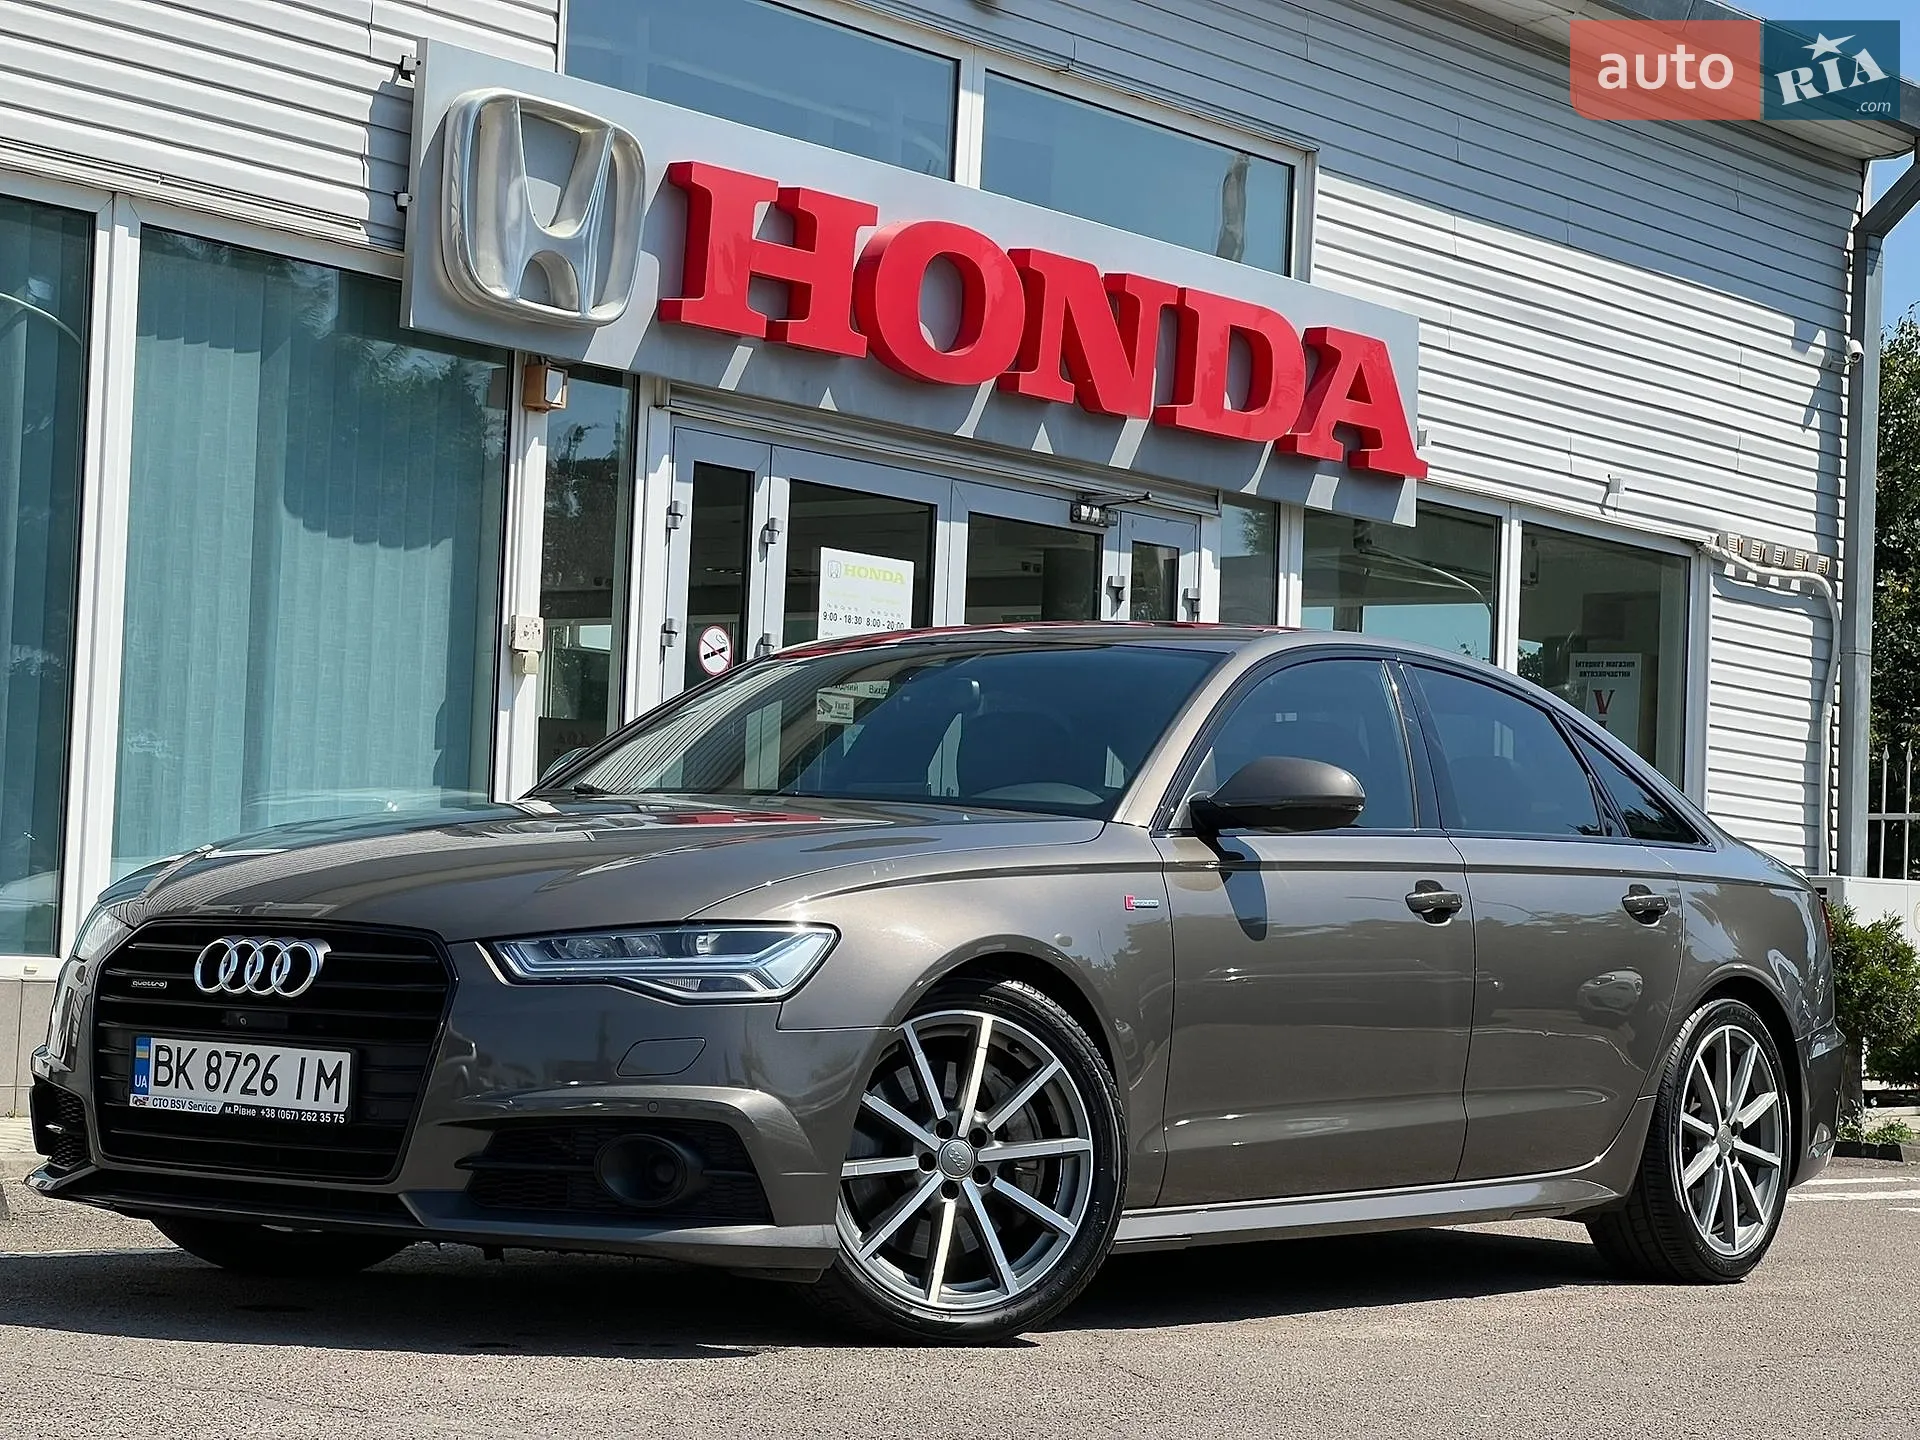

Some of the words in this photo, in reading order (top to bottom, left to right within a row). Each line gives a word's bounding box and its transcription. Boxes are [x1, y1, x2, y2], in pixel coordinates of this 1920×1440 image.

[657, 161, 1428, 479] HONDA
[843, 563, 905, 584] HONDA
[822, 611, 838, 622] 9:00
[844, 614, 863, 625] 18:30
[865, 617, 881, 628] 8:00
[886, 620, 905, 631] 20:00
[134, 1074, 148, 1088] UA
[153, 1044, 198, 1090] BK
[204, 1049, 281, 1097] 8726
[295, 1056, 343, 1104] IM
[170, 1098, 187, 1110] BSV
[187, 1100, 217, 1113] Service
[260, 1108, 276, 1118] +38
[277, 1109, 299, 1120] (067)
[301, 1111, 318, 1122] 262
[319, 1113, 331, 1123] 35
[333, 1113, 345, 1124] 75
